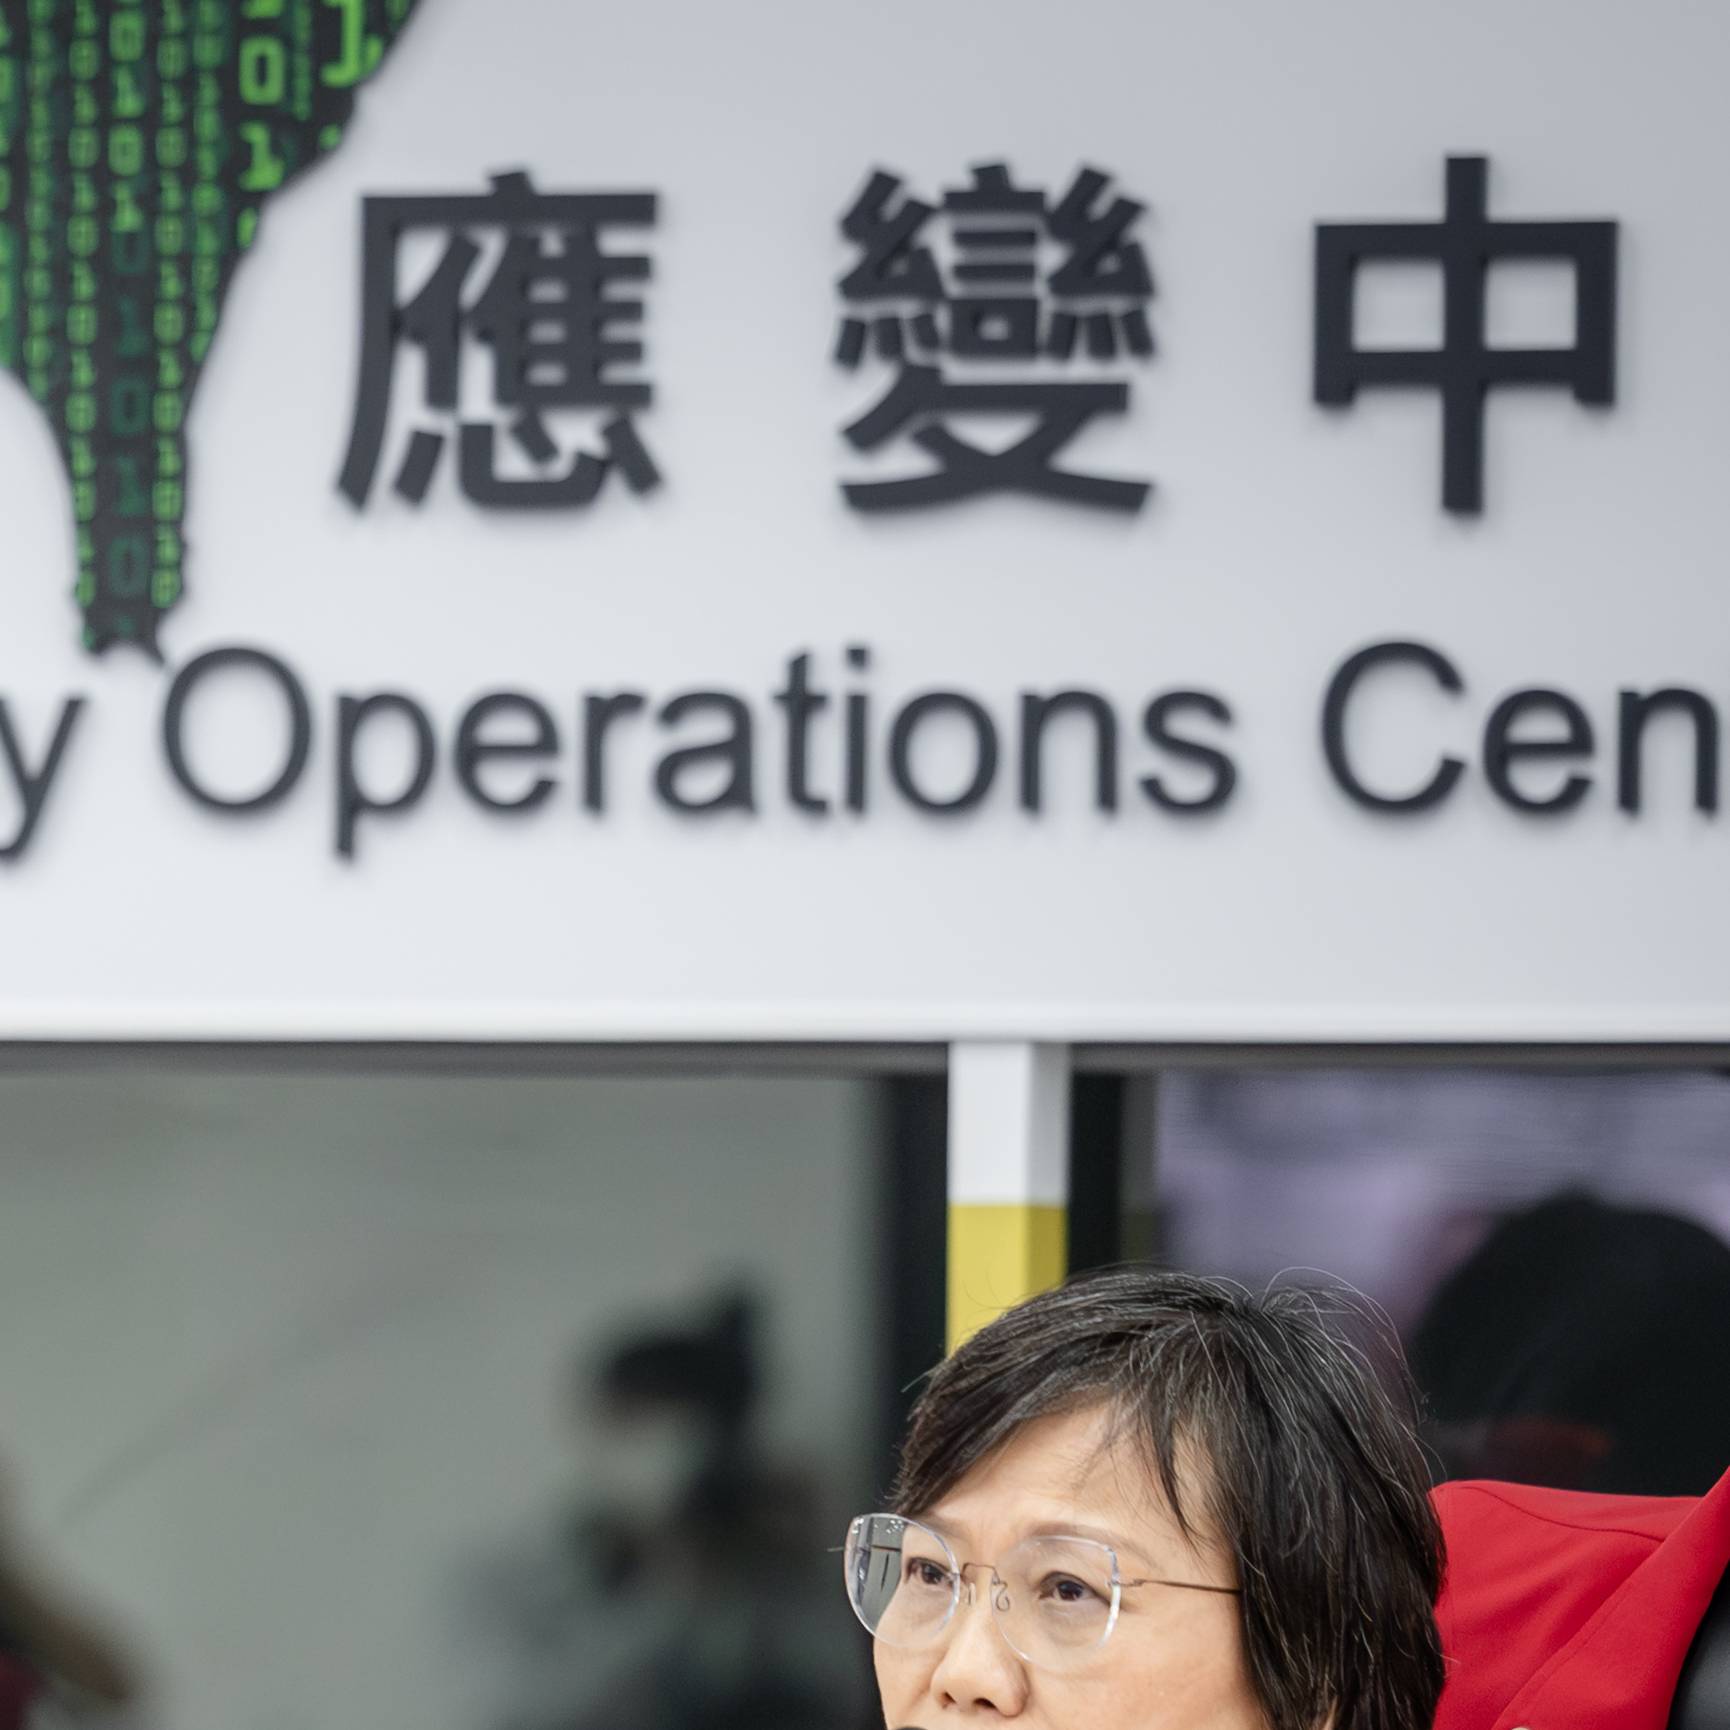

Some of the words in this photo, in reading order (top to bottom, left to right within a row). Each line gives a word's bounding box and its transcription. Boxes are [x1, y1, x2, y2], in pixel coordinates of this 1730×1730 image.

[335, 155, 1622, 521] 應變中
[162, 646, 1239, 860] Operations
[1319, 640, 1723, 821] Cen
